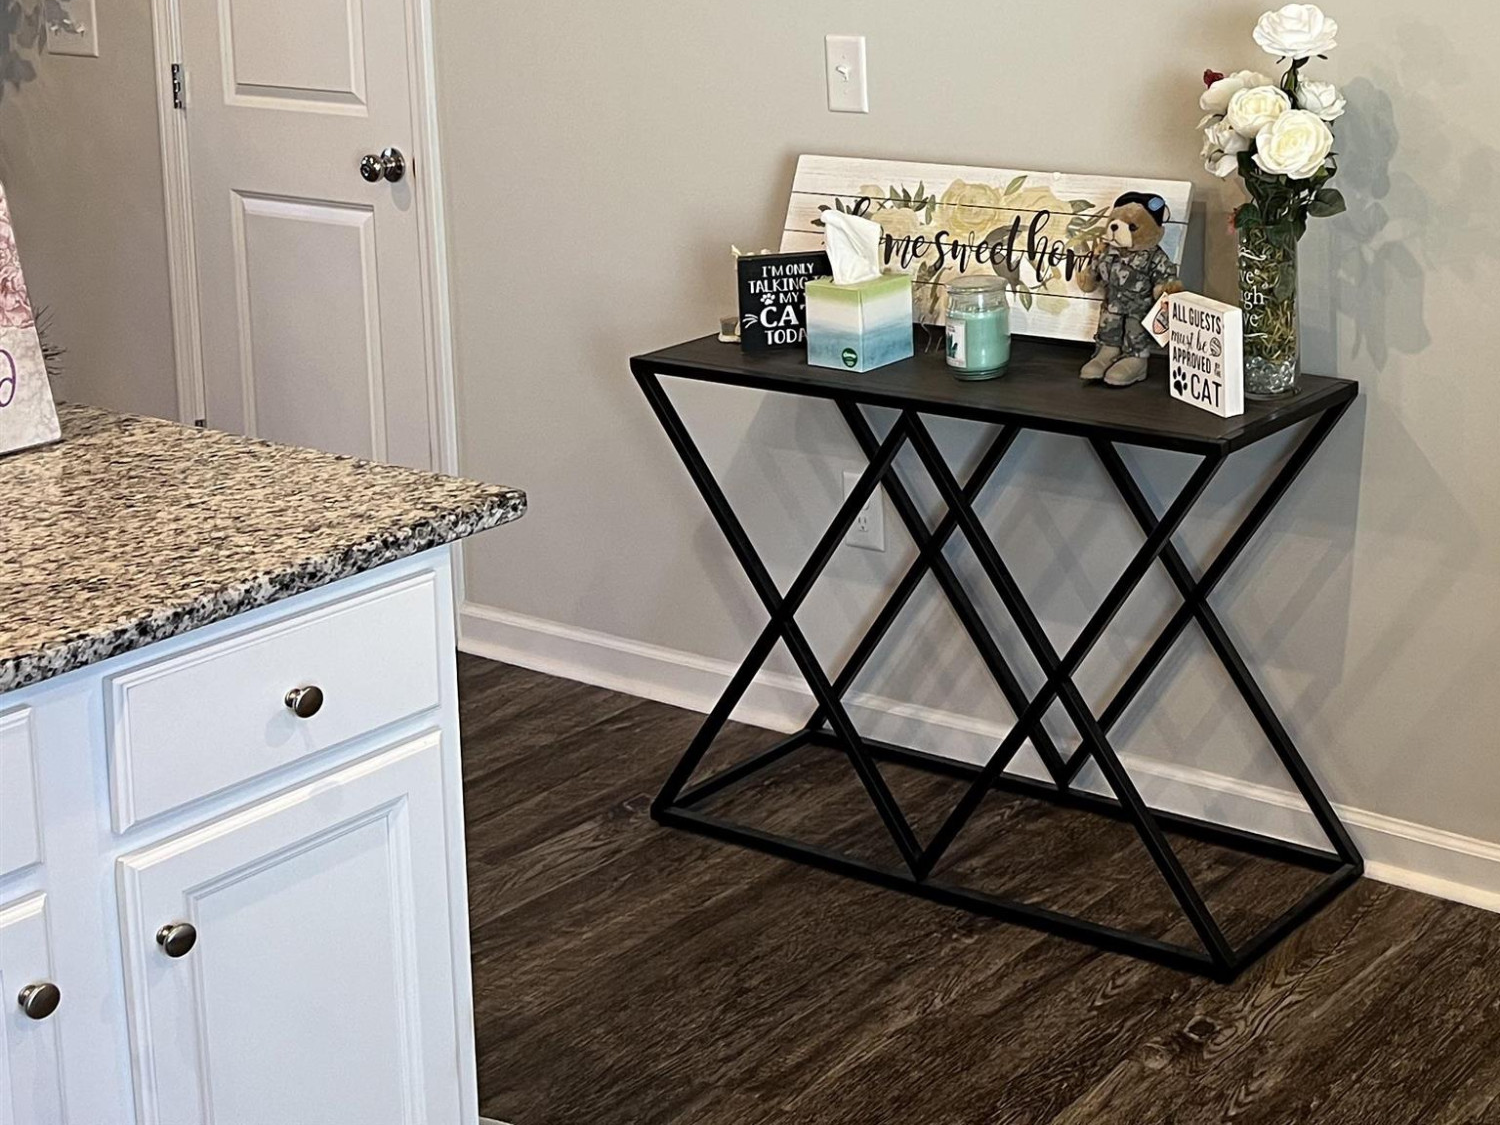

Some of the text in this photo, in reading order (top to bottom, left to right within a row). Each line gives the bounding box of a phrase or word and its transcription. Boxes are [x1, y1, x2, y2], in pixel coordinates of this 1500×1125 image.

[929, 215, 1024, 273] sweet
[1027, 210, 1094, 283] hom
[762, 262, 814, 278] I'M ONLY
[779, 292, 799, 304] MY
[760, 304, 806, 328] CA
[1172, 302, 1222, 335] ALL GUESTS
[764, 327, 808, 346] TODA
[1171, 329, 1208, 354] must be
[1172, 346, 1211, 374] APPROVED
[1190, 374, 1222, 408] CAT
